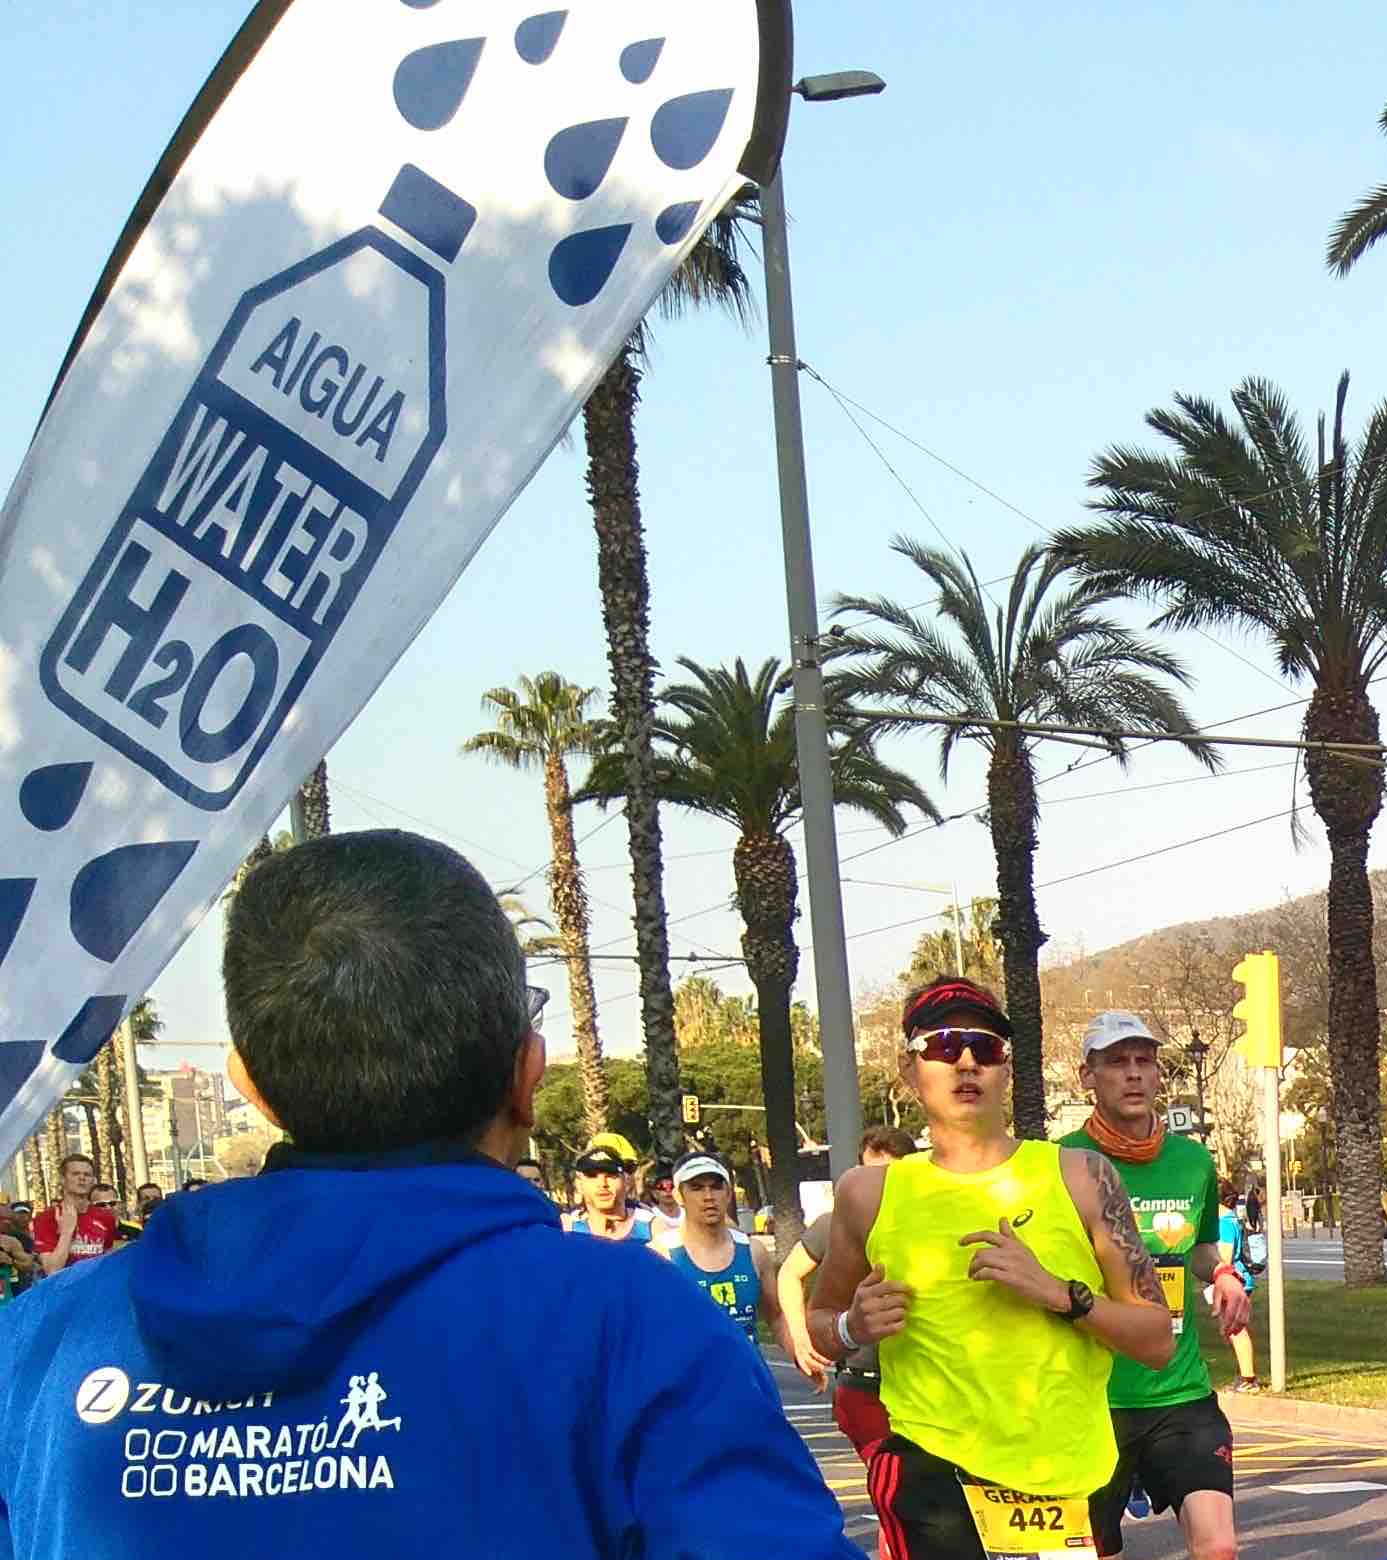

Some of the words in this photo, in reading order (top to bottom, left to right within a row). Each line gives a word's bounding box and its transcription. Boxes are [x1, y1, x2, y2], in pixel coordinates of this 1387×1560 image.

[250, 316, 409, 464] AIGUA
[153, 403, 369, 626] WATER
[184, 1455, 395, 1498] BARCELONA
[1009, 1506, 1065, 1532] 442
